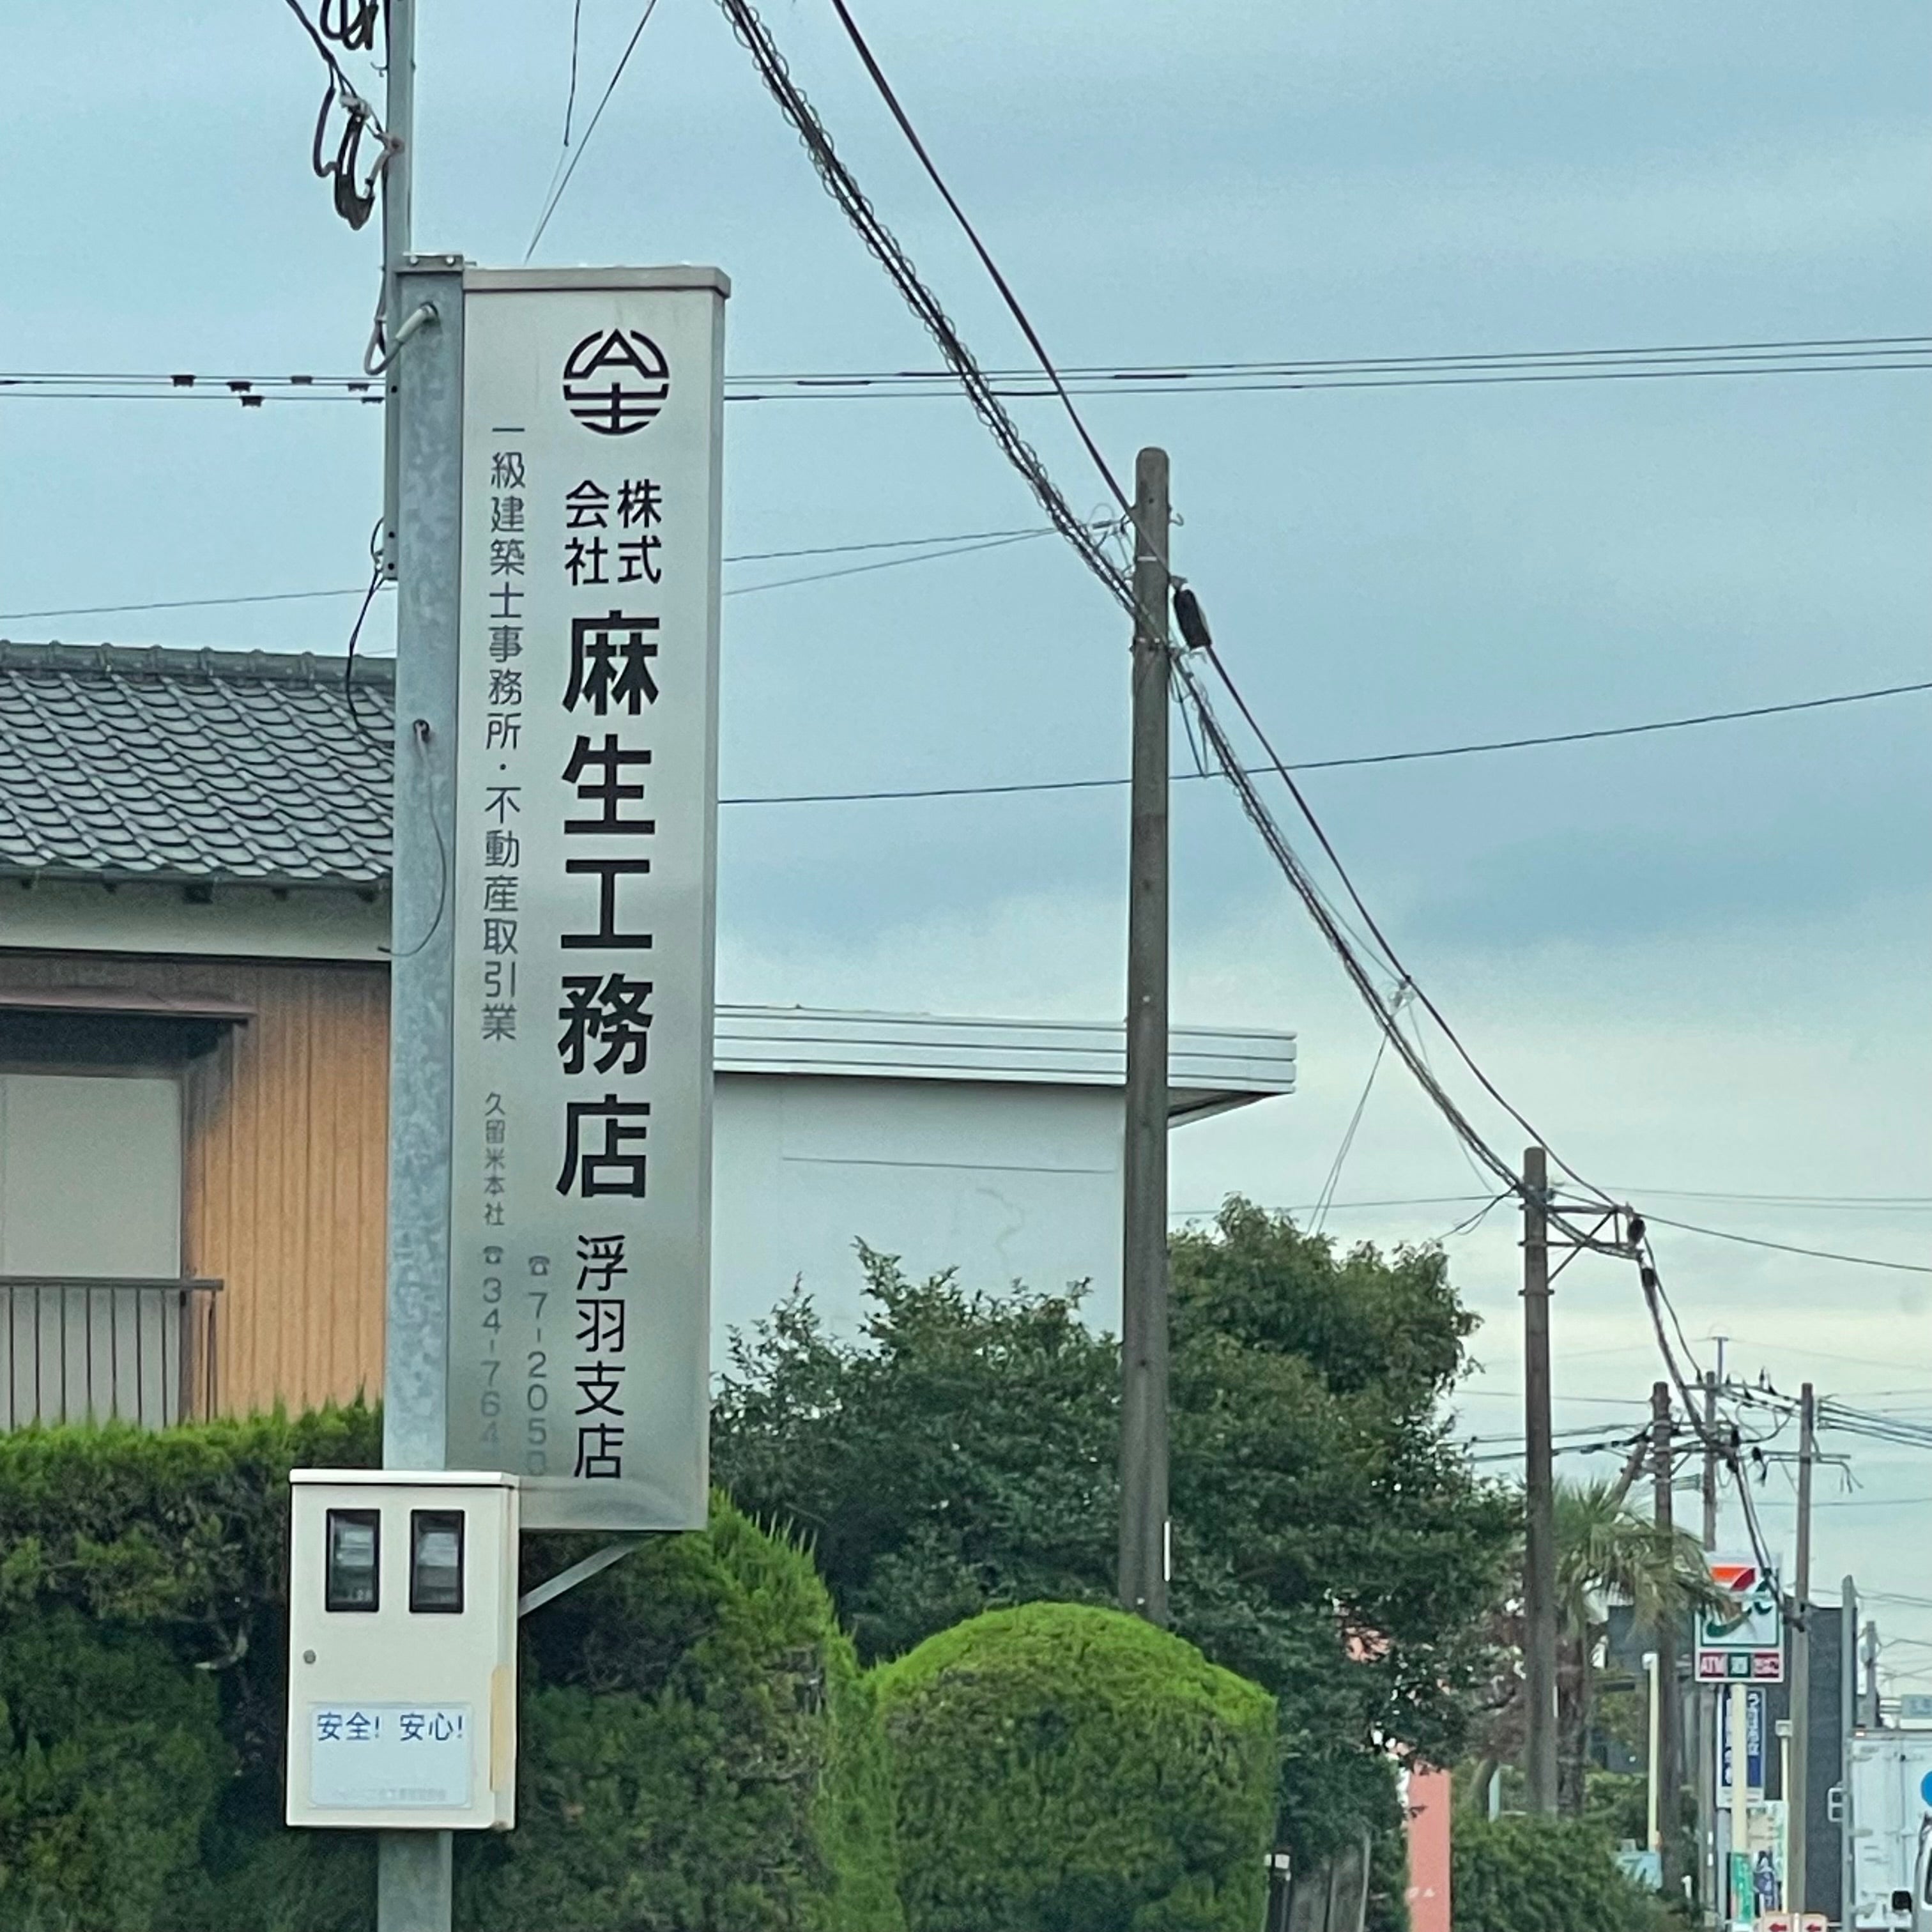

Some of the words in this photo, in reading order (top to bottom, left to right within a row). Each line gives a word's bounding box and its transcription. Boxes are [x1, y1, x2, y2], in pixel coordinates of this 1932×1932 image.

[481, 426, 527, 1042] 一級建築士事務所・不動産取引業
[556, 609, 659, 1198] 麻生工務店
[483, 1091, 507, 1227] 久留米本社
[574, 1234, 628, 1479] 浮羽支店
